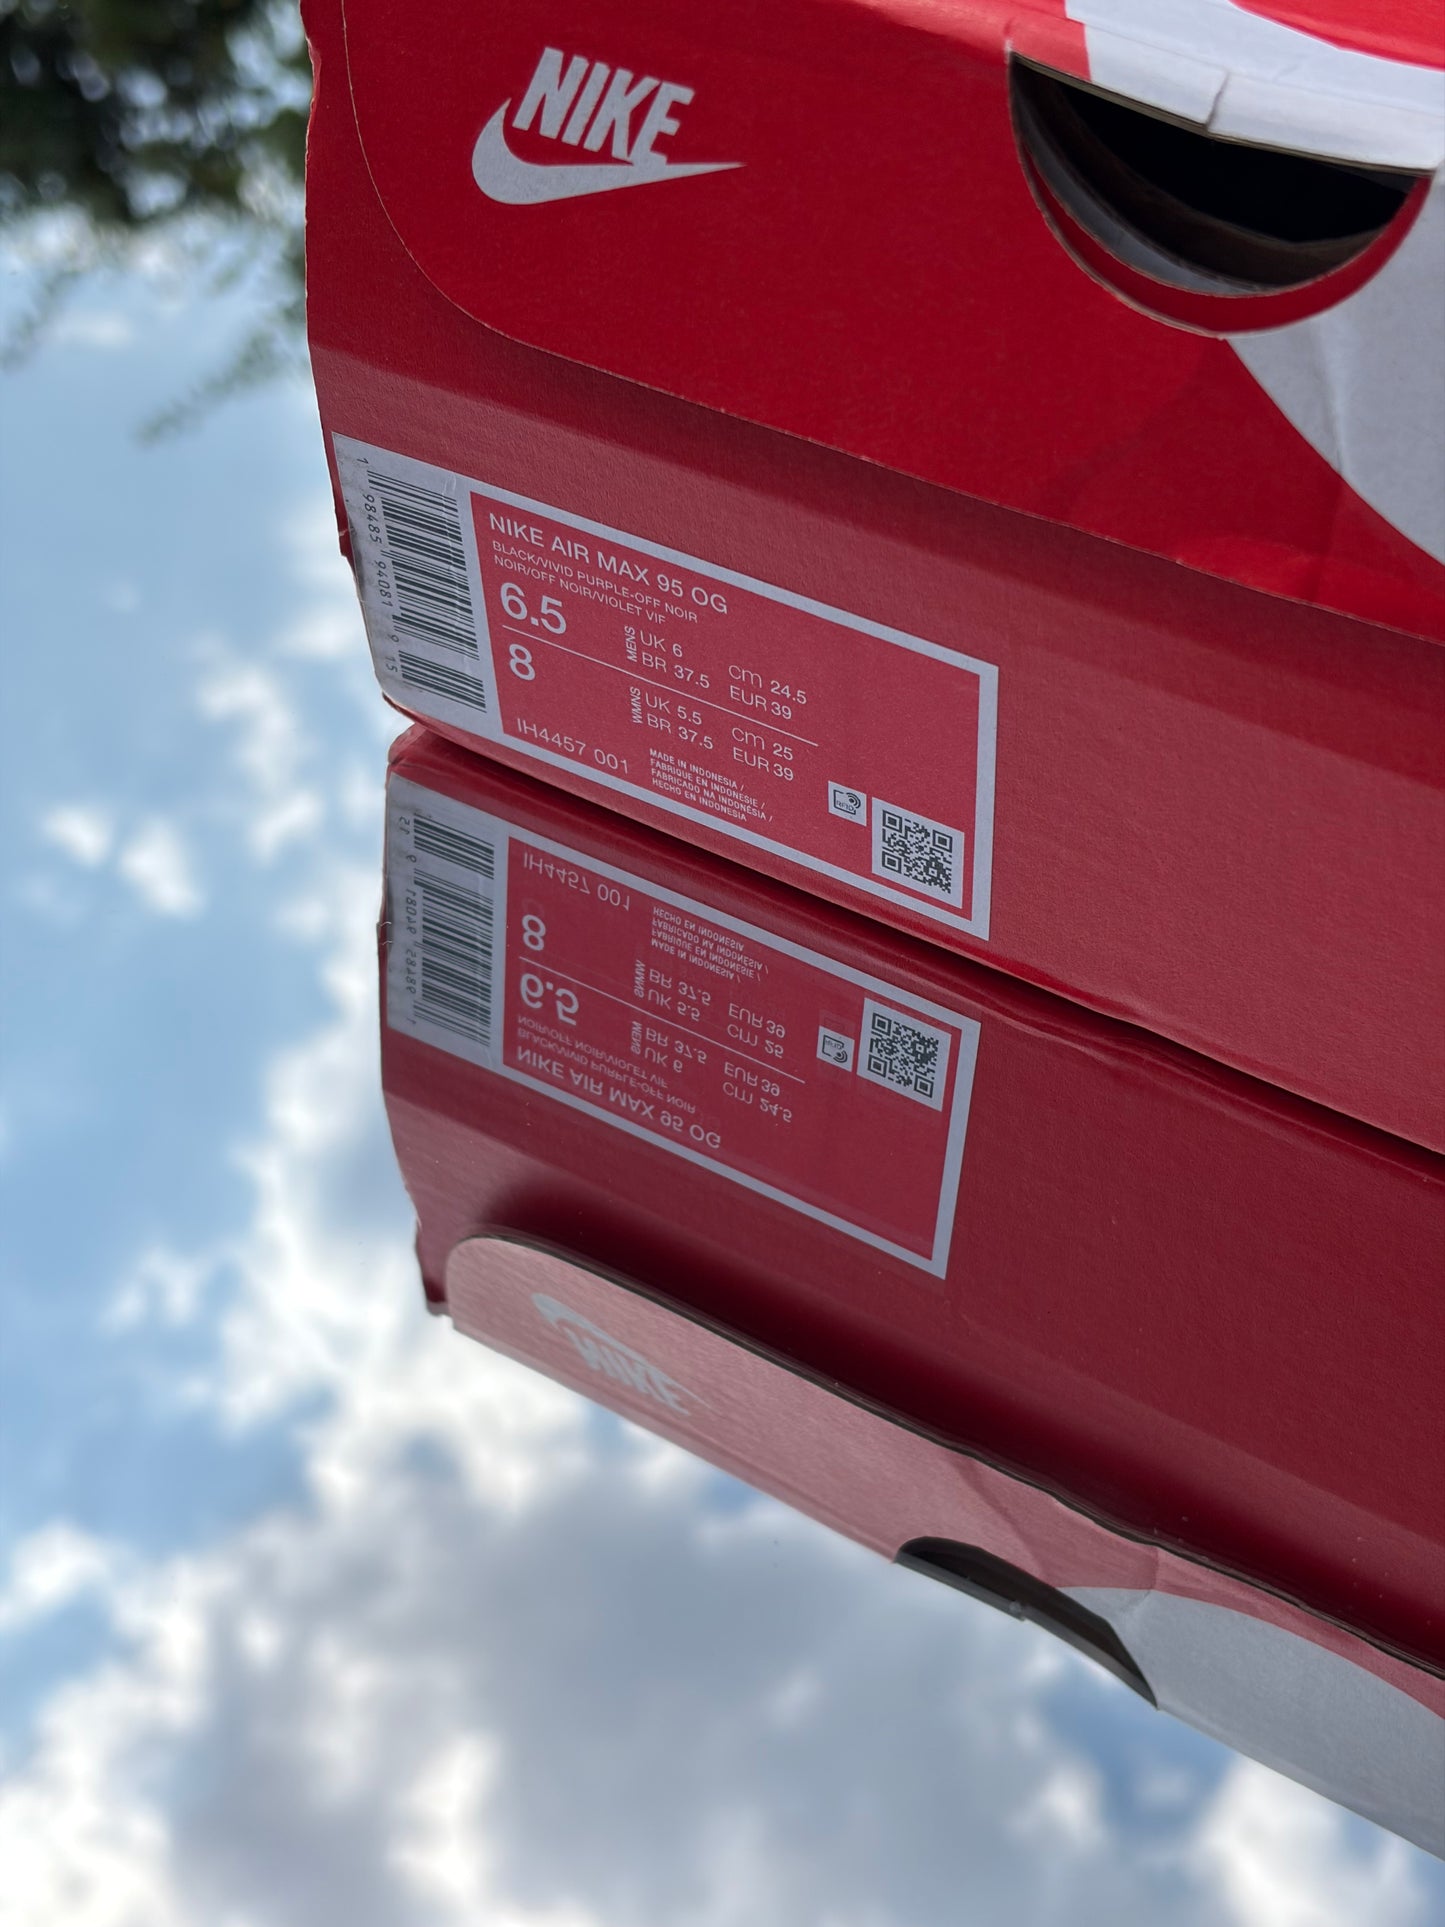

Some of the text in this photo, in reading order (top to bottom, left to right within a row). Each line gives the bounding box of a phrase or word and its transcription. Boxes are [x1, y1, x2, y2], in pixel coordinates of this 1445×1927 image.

[512, 46, 695, 167] NIKE
[489, 512, 728, 615] NIKE AIR MAX 95 OG
[492, 540, 698, 623] BLACK/VIVID PURPLE-OFF NOIR
[362, 494, 383, 544] 98485
[374, 560, 393, 608] 94081
[384, 655, 398, 673] 15
[494, 555, 667, 625] NOIR/OFF NOIR/VIOLET VIF
[500, 582, 567, 635] 6.5
[508, 643, 536, 681] 8
[624, 626, 638, 662] MENS
[640, 630, 683, 658] UK 6
[641, 652, 710, 689] BR 37.5
[630, 686, 643, 724] WMNS
[645, 693, 703, 725] UK 5.5
[729, 685, 792, 720] EUR 39
[770, 680, 807, 705] 24.5
[517, 718, 628, 774] IH4457 001
[647, 713, 714, 750] BR 37.5
[649, 748, 675, 765] MADE
[678, 759, 687, 769] IN
[690, 763, 738, 789] INDONESIA
[733, 747, 794, 781] EUR 39
[772, 743, 793, 761] 25
[650, 758, 693, 782] FABRIQUE
[696, 777, 708, 787] EN
[711, 782, 758, 808] INDONESIE
[651, 768, 700, 794] FABRICADO
[703, 789, 715, 800] NA
[652, 778, 747, 822] HECHO EN INDONESIA
